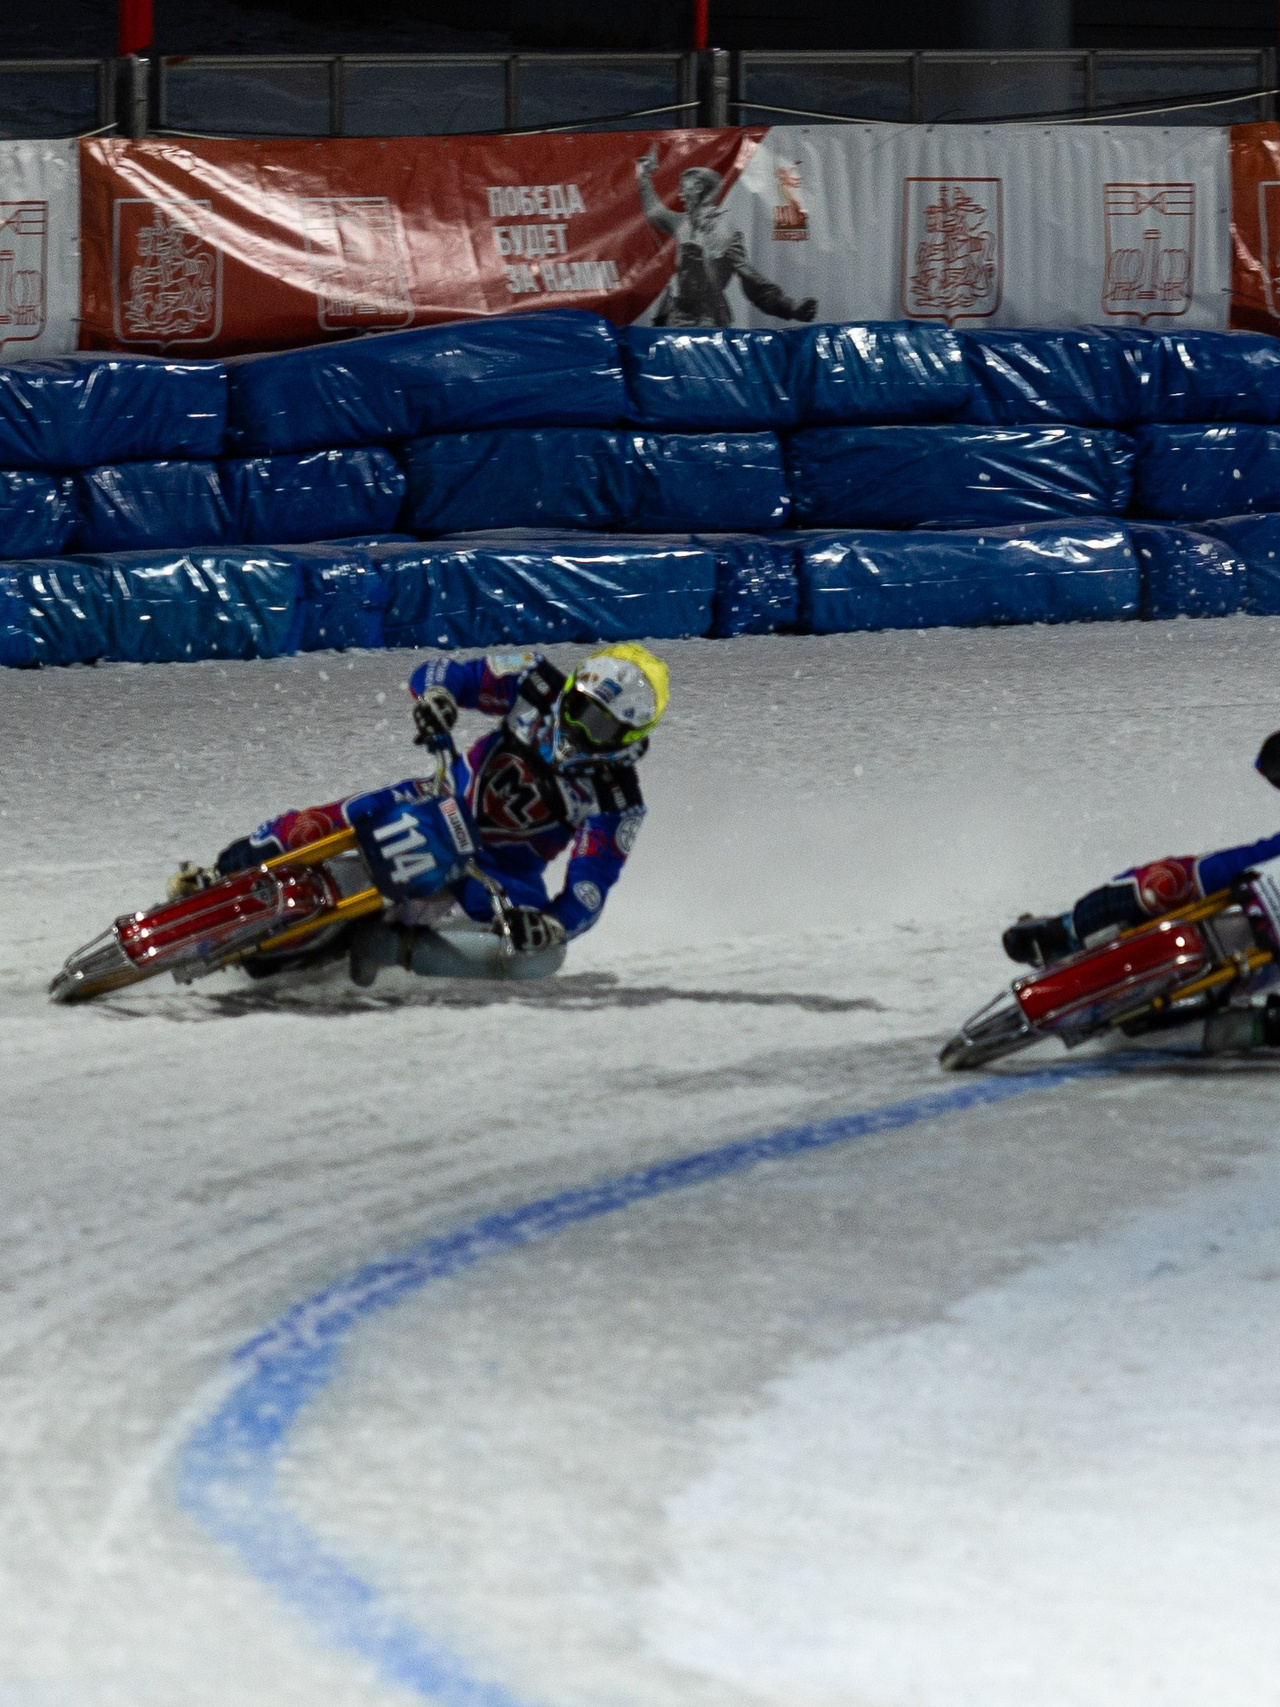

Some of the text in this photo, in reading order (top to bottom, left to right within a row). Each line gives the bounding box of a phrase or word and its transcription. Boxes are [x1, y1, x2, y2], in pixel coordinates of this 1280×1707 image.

[487, 184, 587, 220] ПОБЕДА
[494, 223, 568, 259] БУДЕТ
[539, 260, 622, 292] НАМИ!
[373, 812, 437, 884] 114
